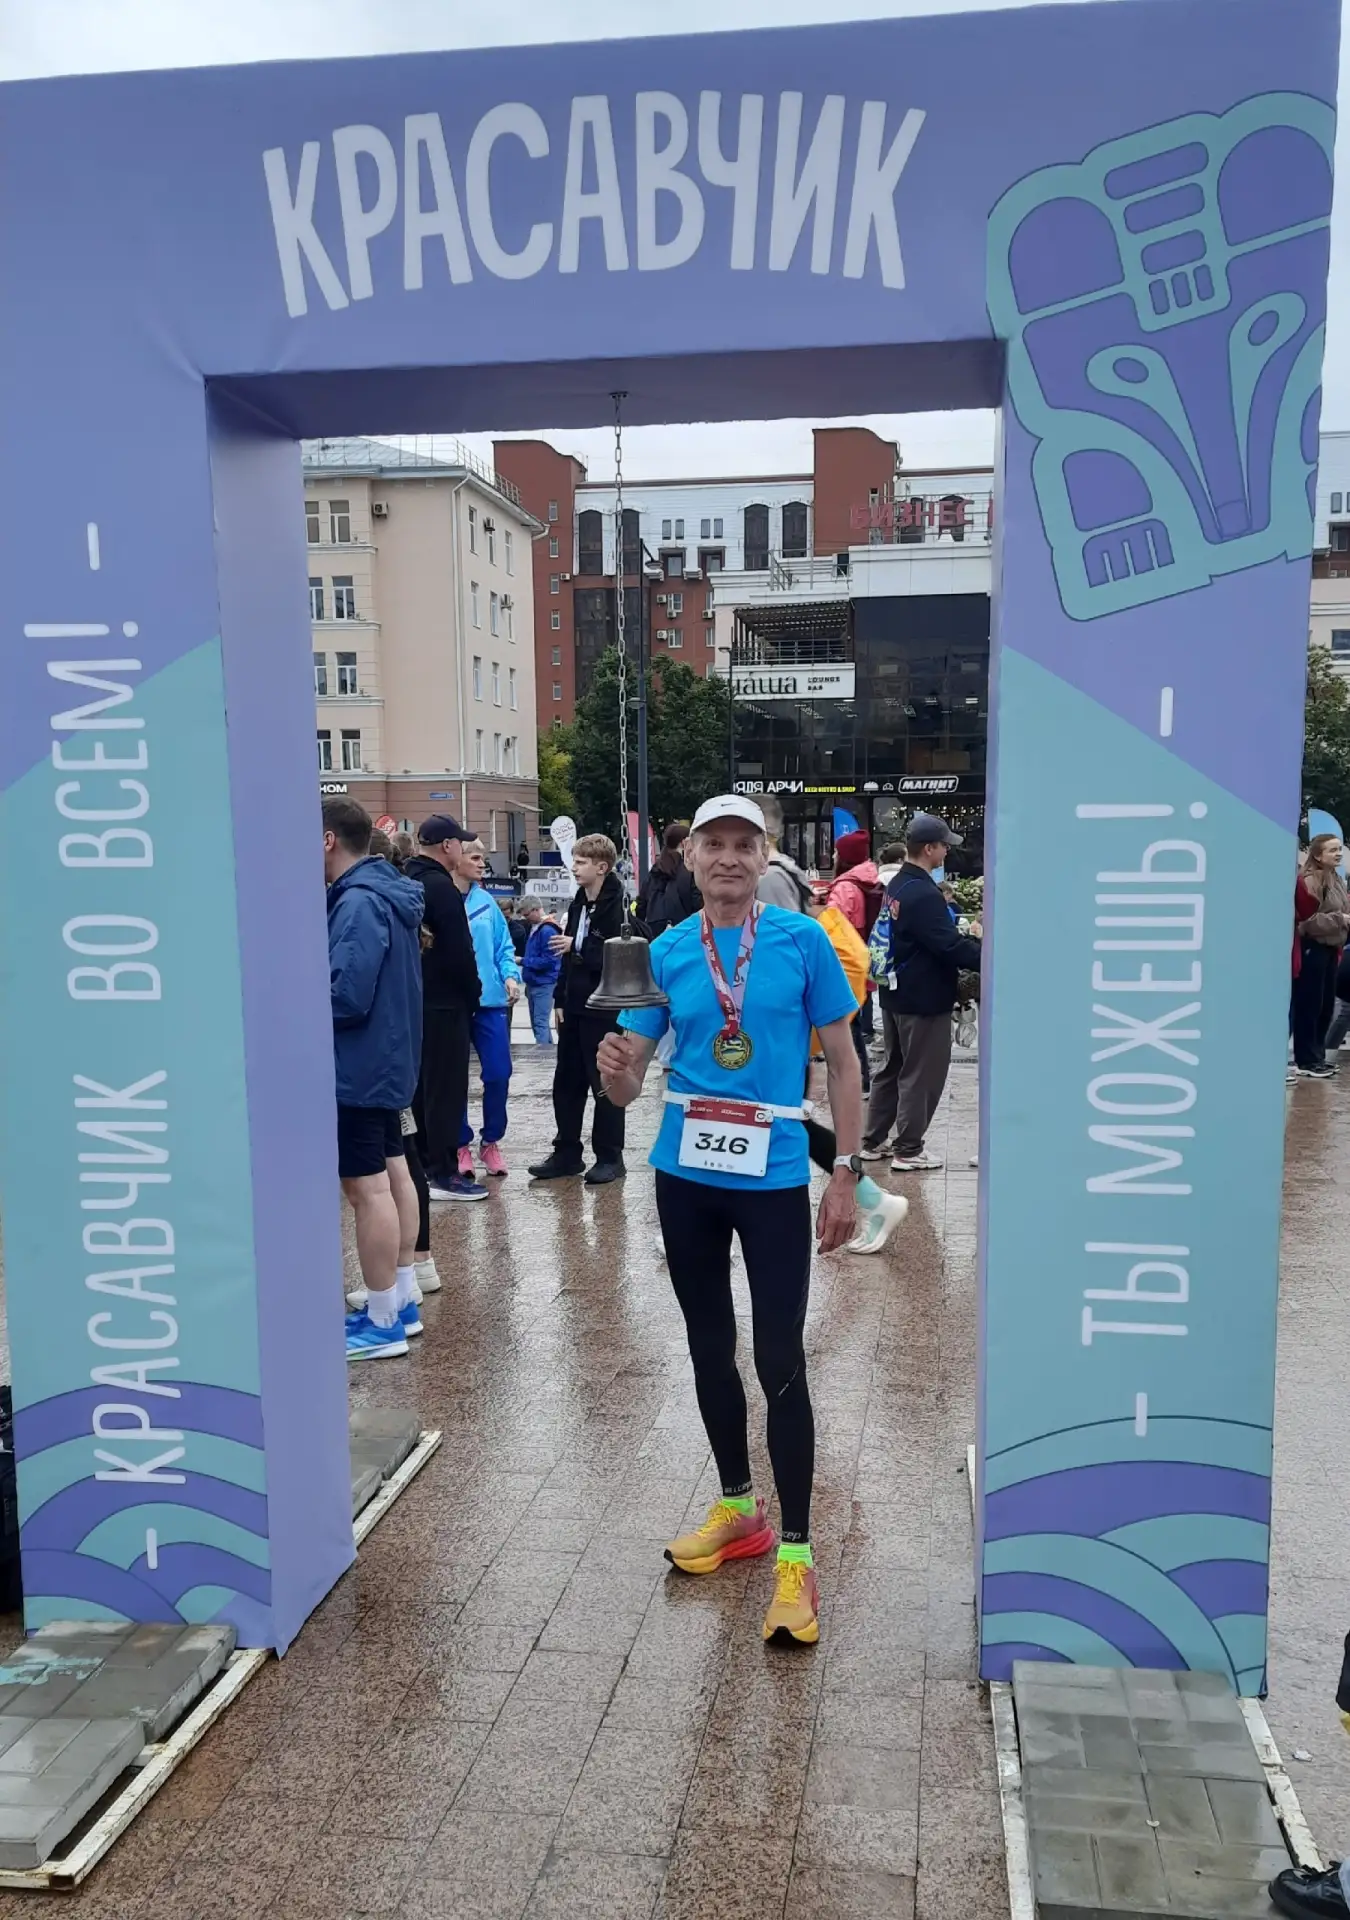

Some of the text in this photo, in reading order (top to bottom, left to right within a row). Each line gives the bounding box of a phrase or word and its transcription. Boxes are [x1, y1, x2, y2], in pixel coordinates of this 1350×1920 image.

[262, 90, 926, 318] КРАСАВЧИК
[24, 621, 153, 868] ВСЕМ!
[766, 780, 804, 793] АРЧИ
[902, 780, 956, 790] МАГНИТ
[62, 914, 161, 1000] ВО
[1076, 801, 1207, 1195] МОЖЕШЬ!
[694, 1132, 749, 1155] 316
[73, 1070, 186, 1484] КРАСАВЧИК
[1081, 1241, 1190, 1346] ТЫ
